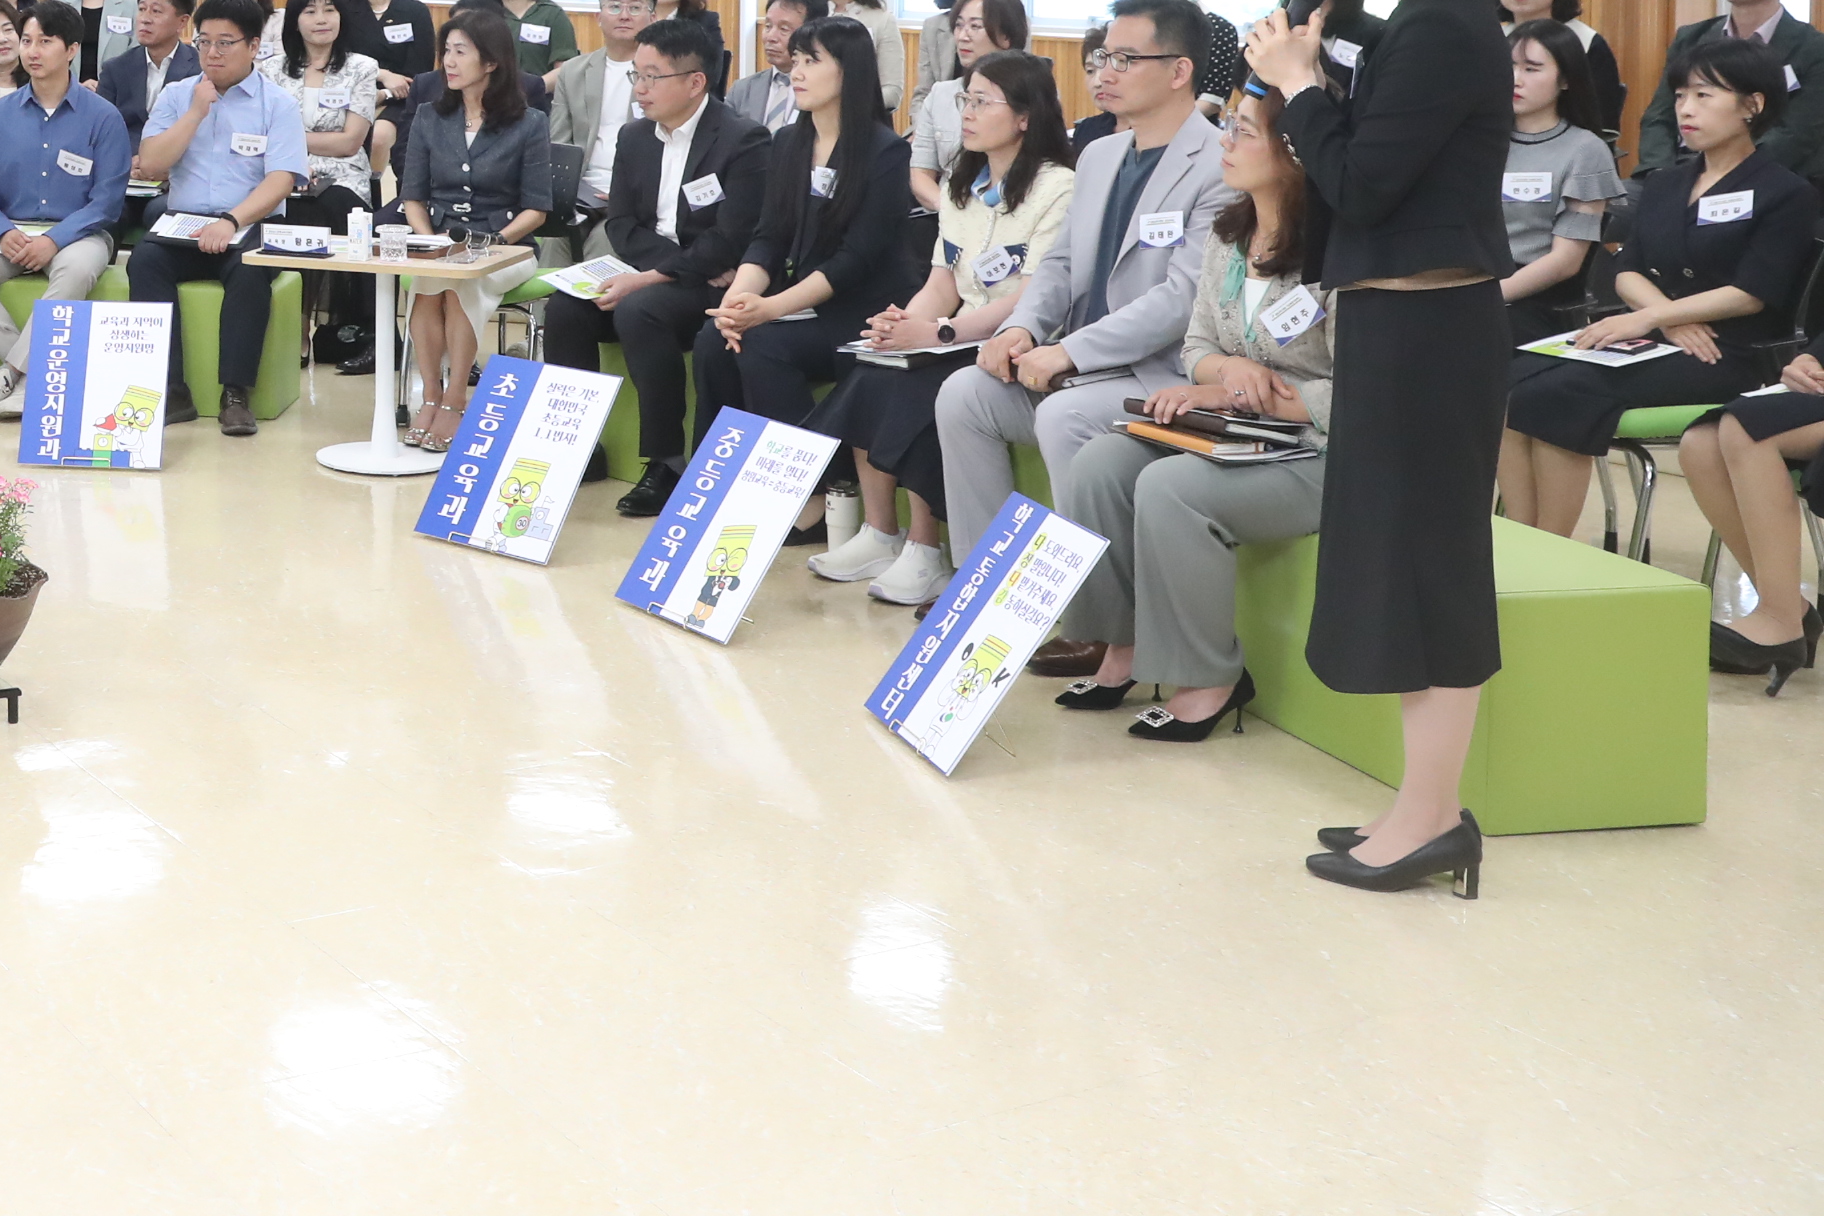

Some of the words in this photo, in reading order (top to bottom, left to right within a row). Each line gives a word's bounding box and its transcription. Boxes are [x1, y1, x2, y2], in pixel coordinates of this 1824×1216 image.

[695, 190, 715, 201] 김기호
[100, 316, 129, 326] 교육과
[133, 317, 162, 327] 지역이
[1281, 308, 1309, 332] 임현주
[110, 329, 148, 340] 상생하는
[37, 305, 74, 460] 학교운영지원과
[546, 382, 576, 397] 실력은
[547, 398, 588, 415] 대한민국
[543, 412, 581, 430] 초등교육
[437, 373, 520, 525] 초등교육과
[766, 440, 793, 459] 학교를
[792, 449, 818, 466] 품다!
[755, 456, 784, 474] 미래를
[783, 465, 808, 482] 열다!
[741, 469, 769, 487] 창원교육
[773, 480, 806, 498] 중등교육!
[639, 426, 745, 592] 중등교육과
[518, 519, 527, 528] 30
[1034, 534, 1046, 550] 다
[1009, 570, 1021, 586] 다
[880, 502, 1034, 720] 학교통합지원센터
